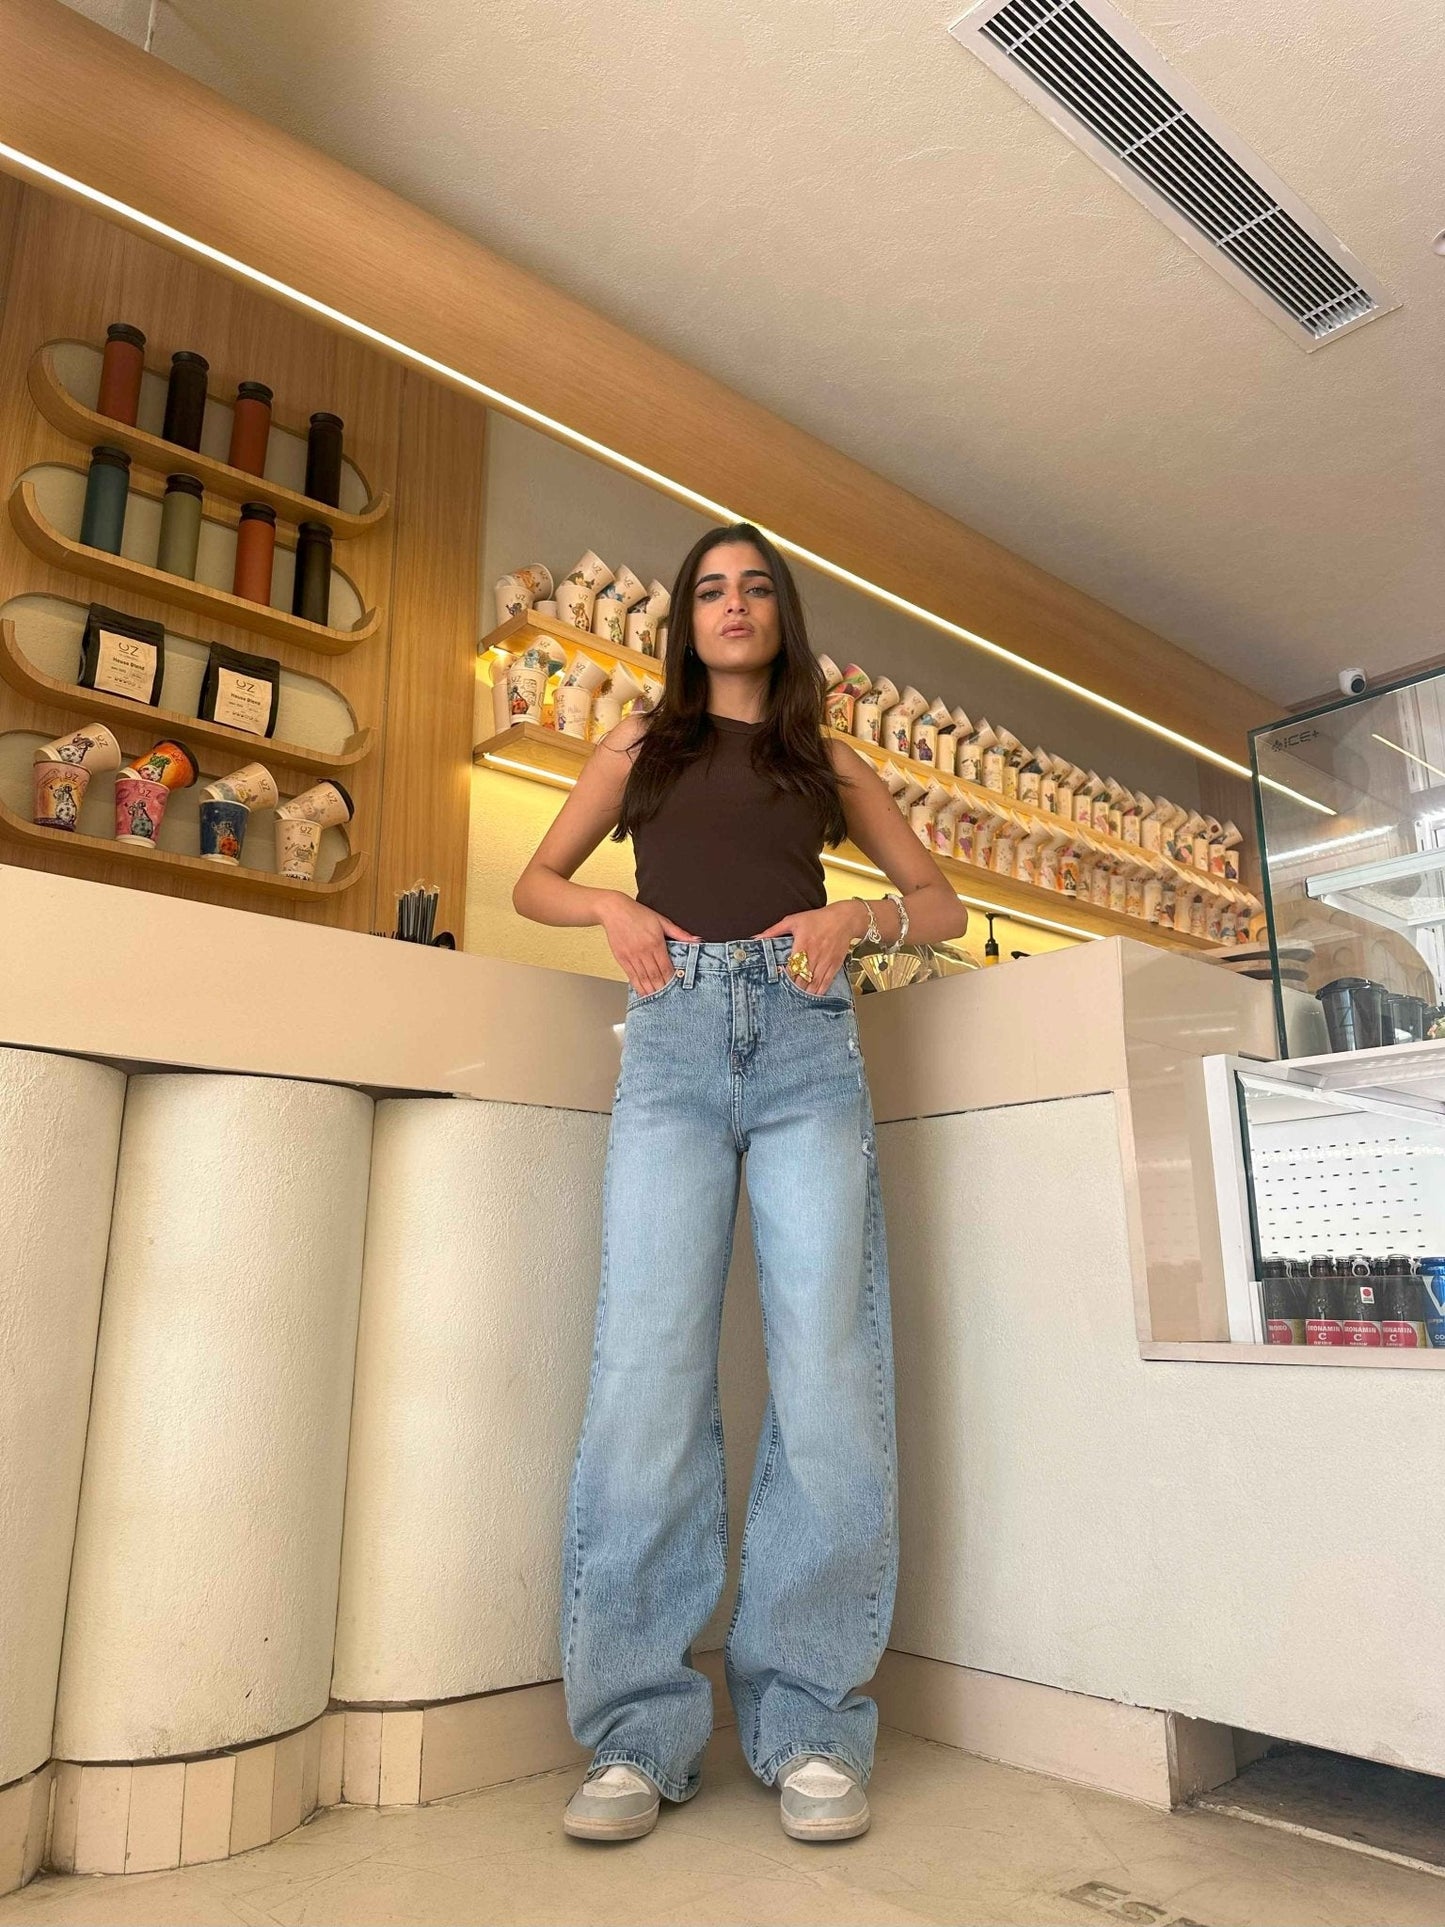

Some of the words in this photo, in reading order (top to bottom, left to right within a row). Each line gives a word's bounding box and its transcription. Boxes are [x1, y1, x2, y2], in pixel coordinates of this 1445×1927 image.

[1318, 1332, 1327, 1340] C
[1353, 1333, 1362, 1341] C
[1389, 1334, 1397, 1342] C
